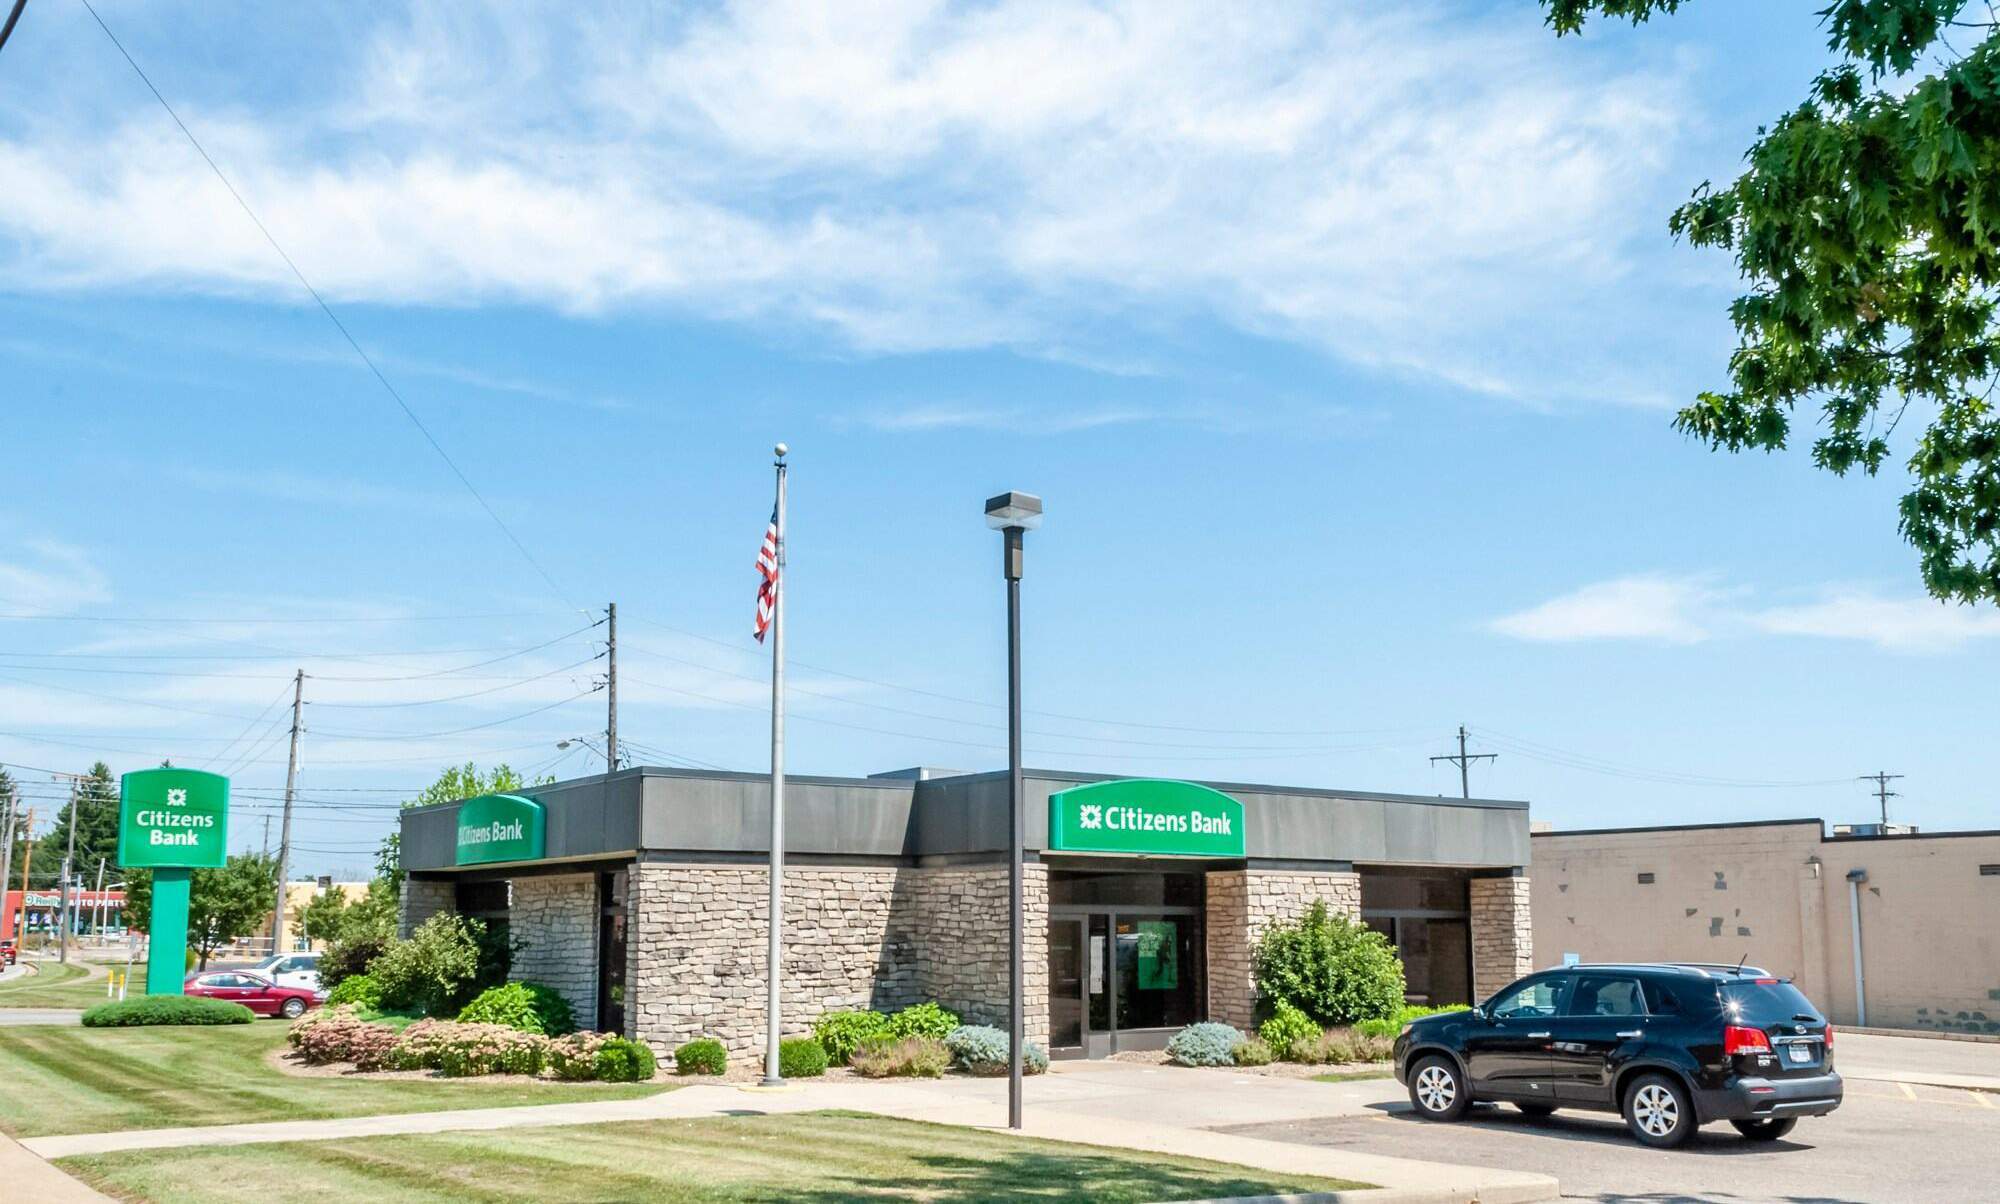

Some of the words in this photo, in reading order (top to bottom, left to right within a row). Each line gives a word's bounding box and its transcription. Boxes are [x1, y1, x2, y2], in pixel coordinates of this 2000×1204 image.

[136, 810, 214, 828] Citizens
[1105, 806, 1188, 833] Citizens
[1191, 810, 1232, 836] Bank
[150, 829, 199, 846] Bank
[463, 825, 491, 845] Citizens
[492, 818, 523, 842] Bank
